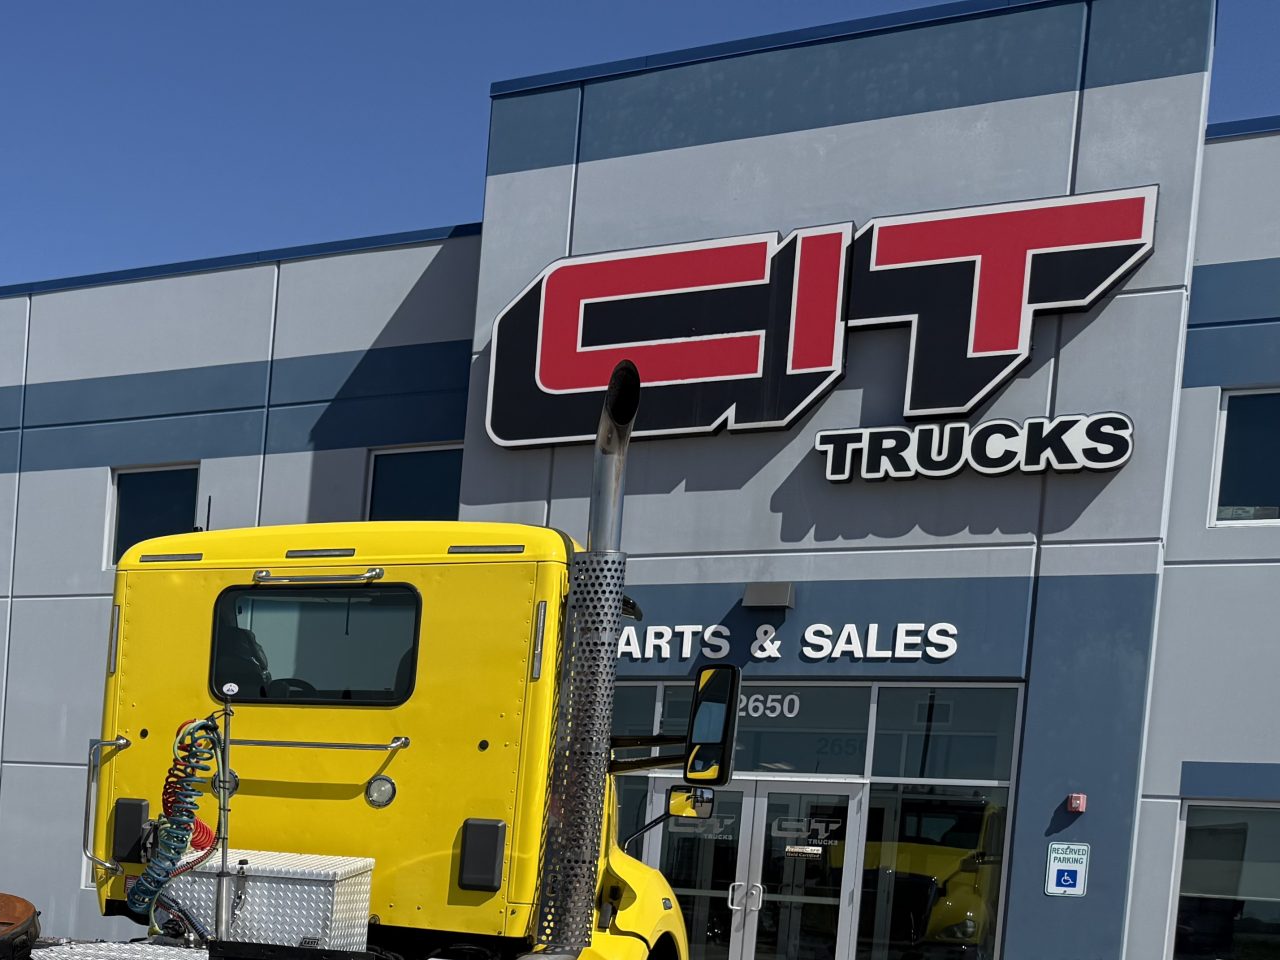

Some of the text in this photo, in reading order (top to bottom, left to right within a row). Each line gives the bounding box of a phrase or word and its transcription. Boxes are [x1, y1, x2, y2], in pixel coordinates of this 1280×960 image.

[488, 187, 1158, 440] CIT
[818, 415, 1131, 478] TRUCKS
[617, 623, 958, 659] ARTS & SALES
[704, 833, 733, 841] TRUCKS
[1051, 847, 1087, 856] RESERVED
[1053, 856, 1084, 865] PARKING
